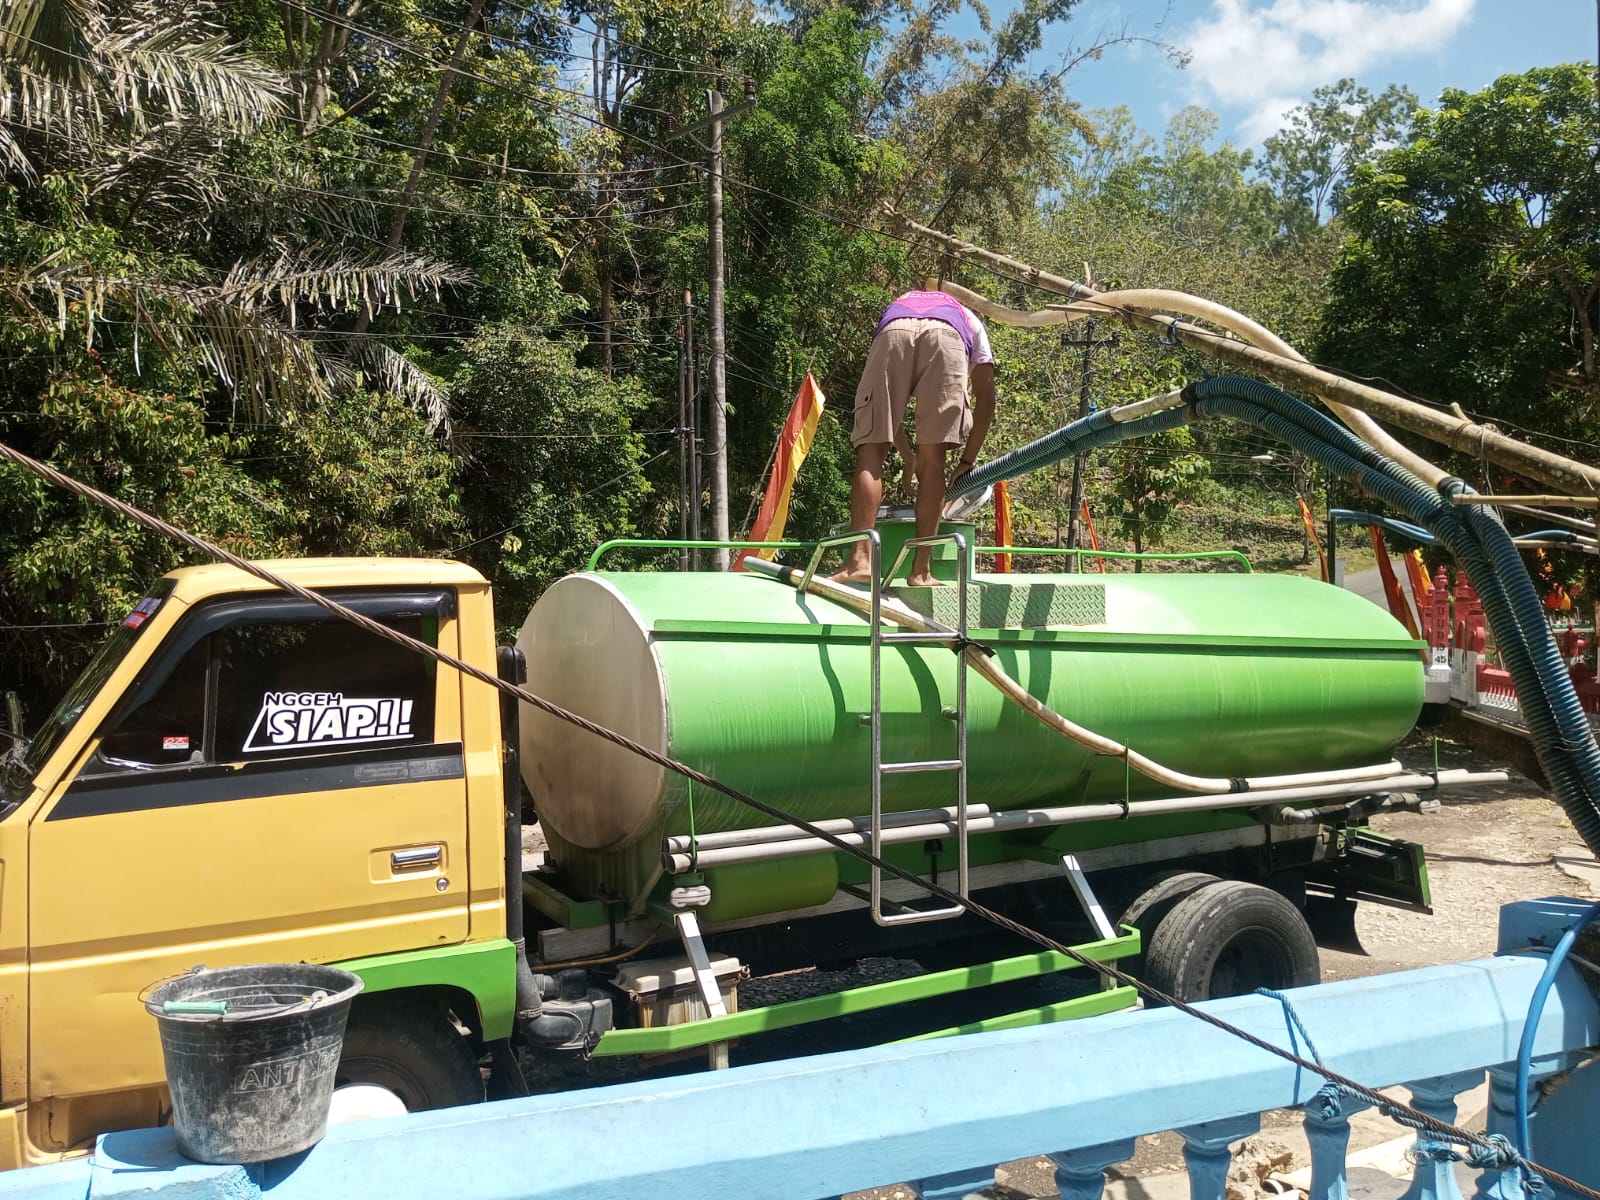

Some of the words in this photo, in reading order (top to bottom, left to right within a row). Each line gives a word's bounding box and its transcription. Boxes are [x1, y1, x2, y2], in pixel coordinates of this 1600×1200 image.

[1435, 655, 1447, 663] 45
[264, 692, 343, 707] NGGEH
[271, 700, 414, 743] SIAP!!
[240, 1058, 306, 1089] ANTI
